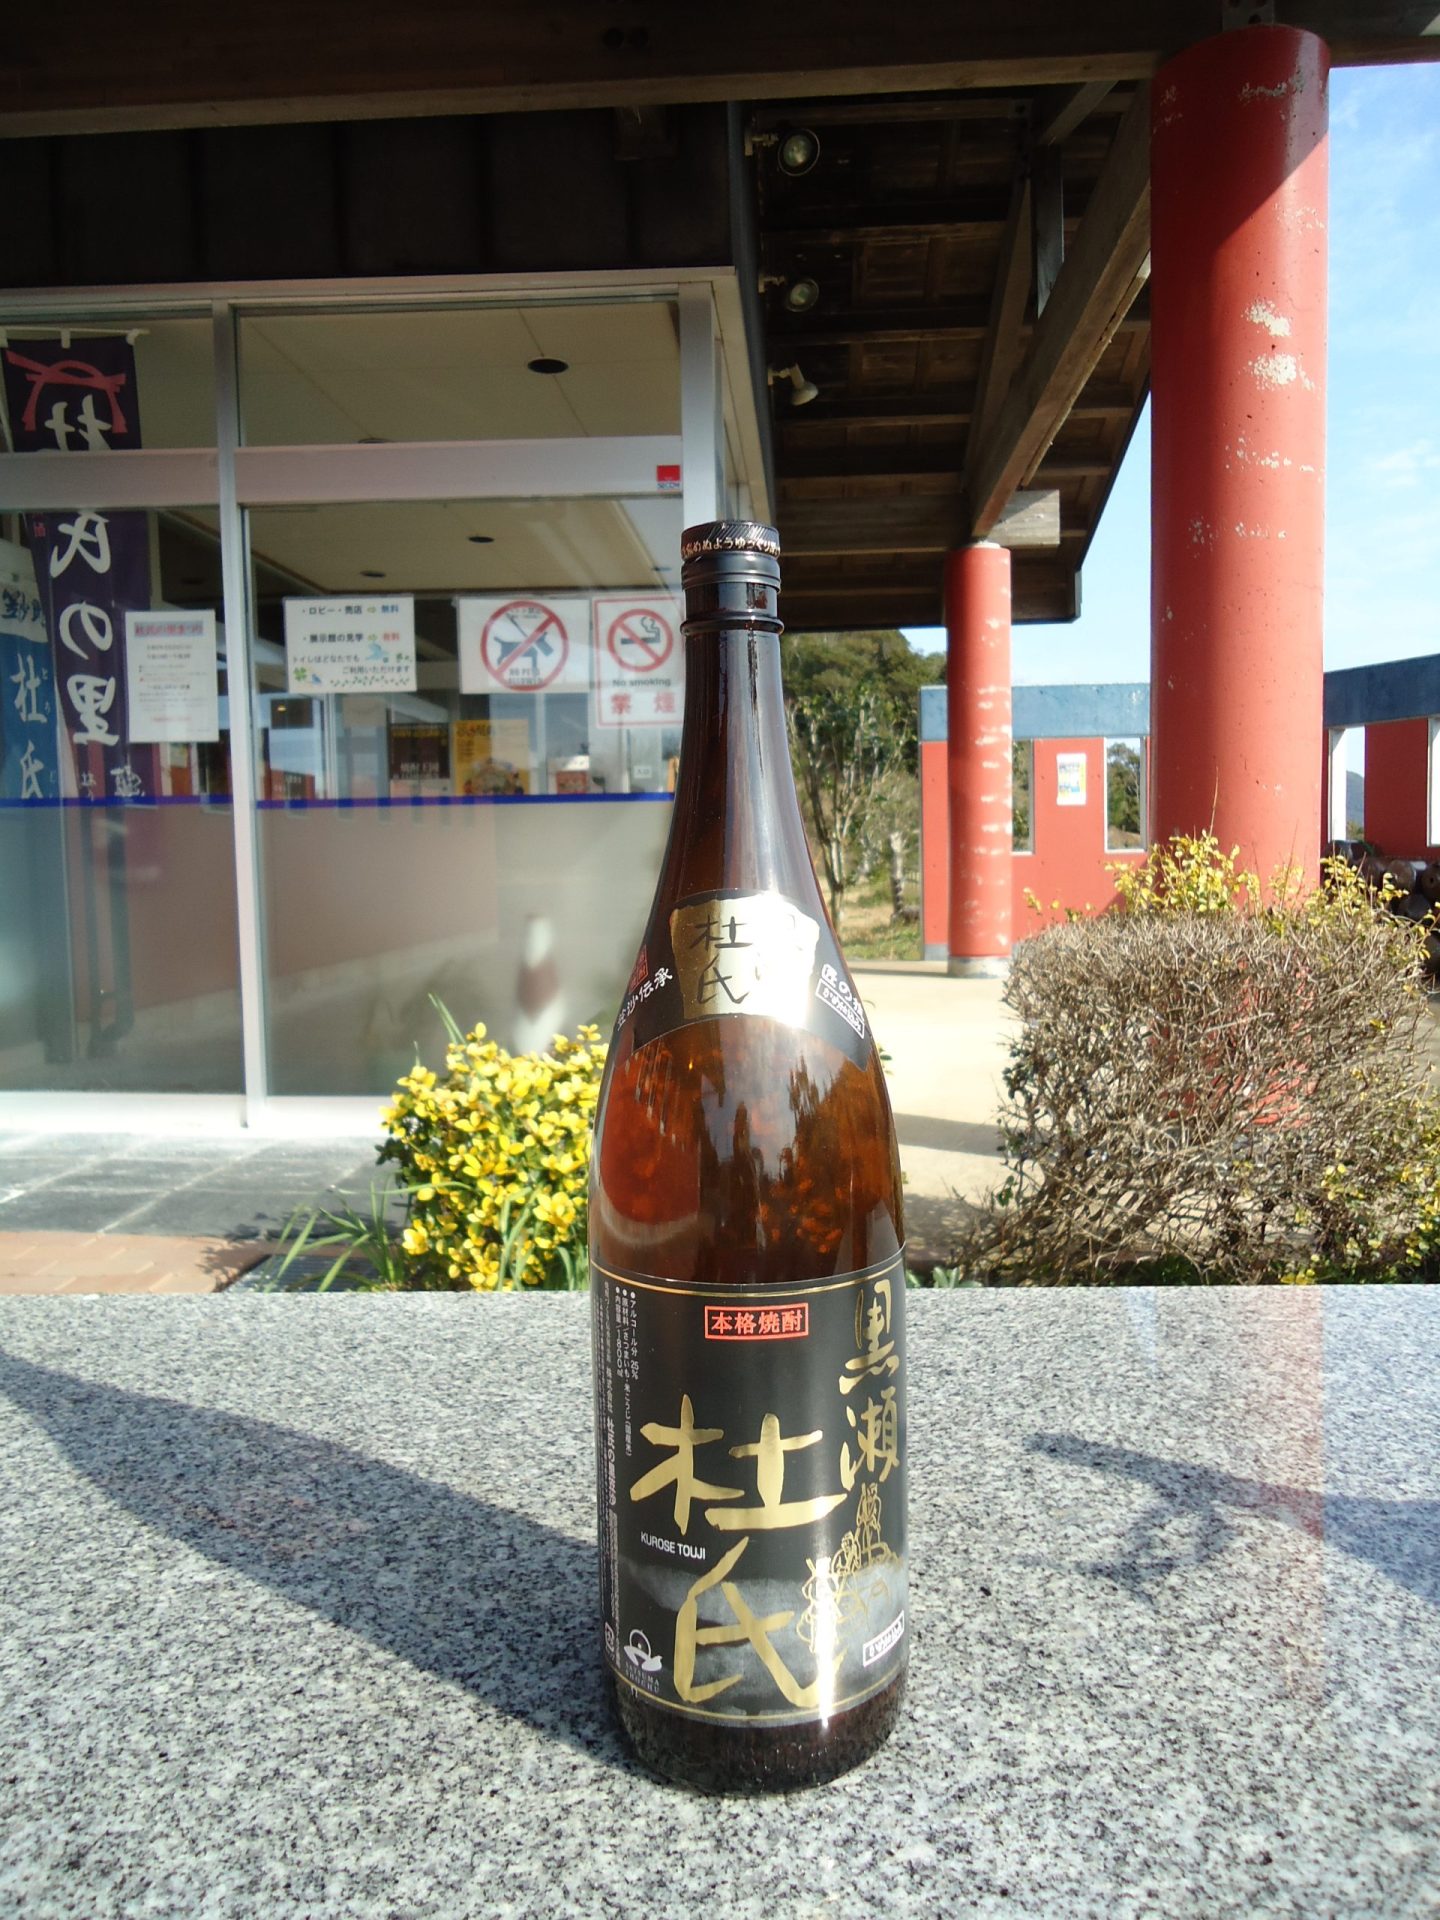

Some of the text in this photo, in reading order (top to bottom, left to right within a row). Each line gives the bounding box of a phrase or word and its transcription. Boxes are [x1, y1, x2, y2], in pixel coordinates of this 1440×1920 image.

[629, 678, 671, 688] smoking
[689, 914, 753, 1004] 杜氏
[711, 1310, 803, 1335] 本格焼酎
[838, 1279, 901, 1489] 黒瀬
[641, 1533, 706, 1561] KUROSE TOUJI
